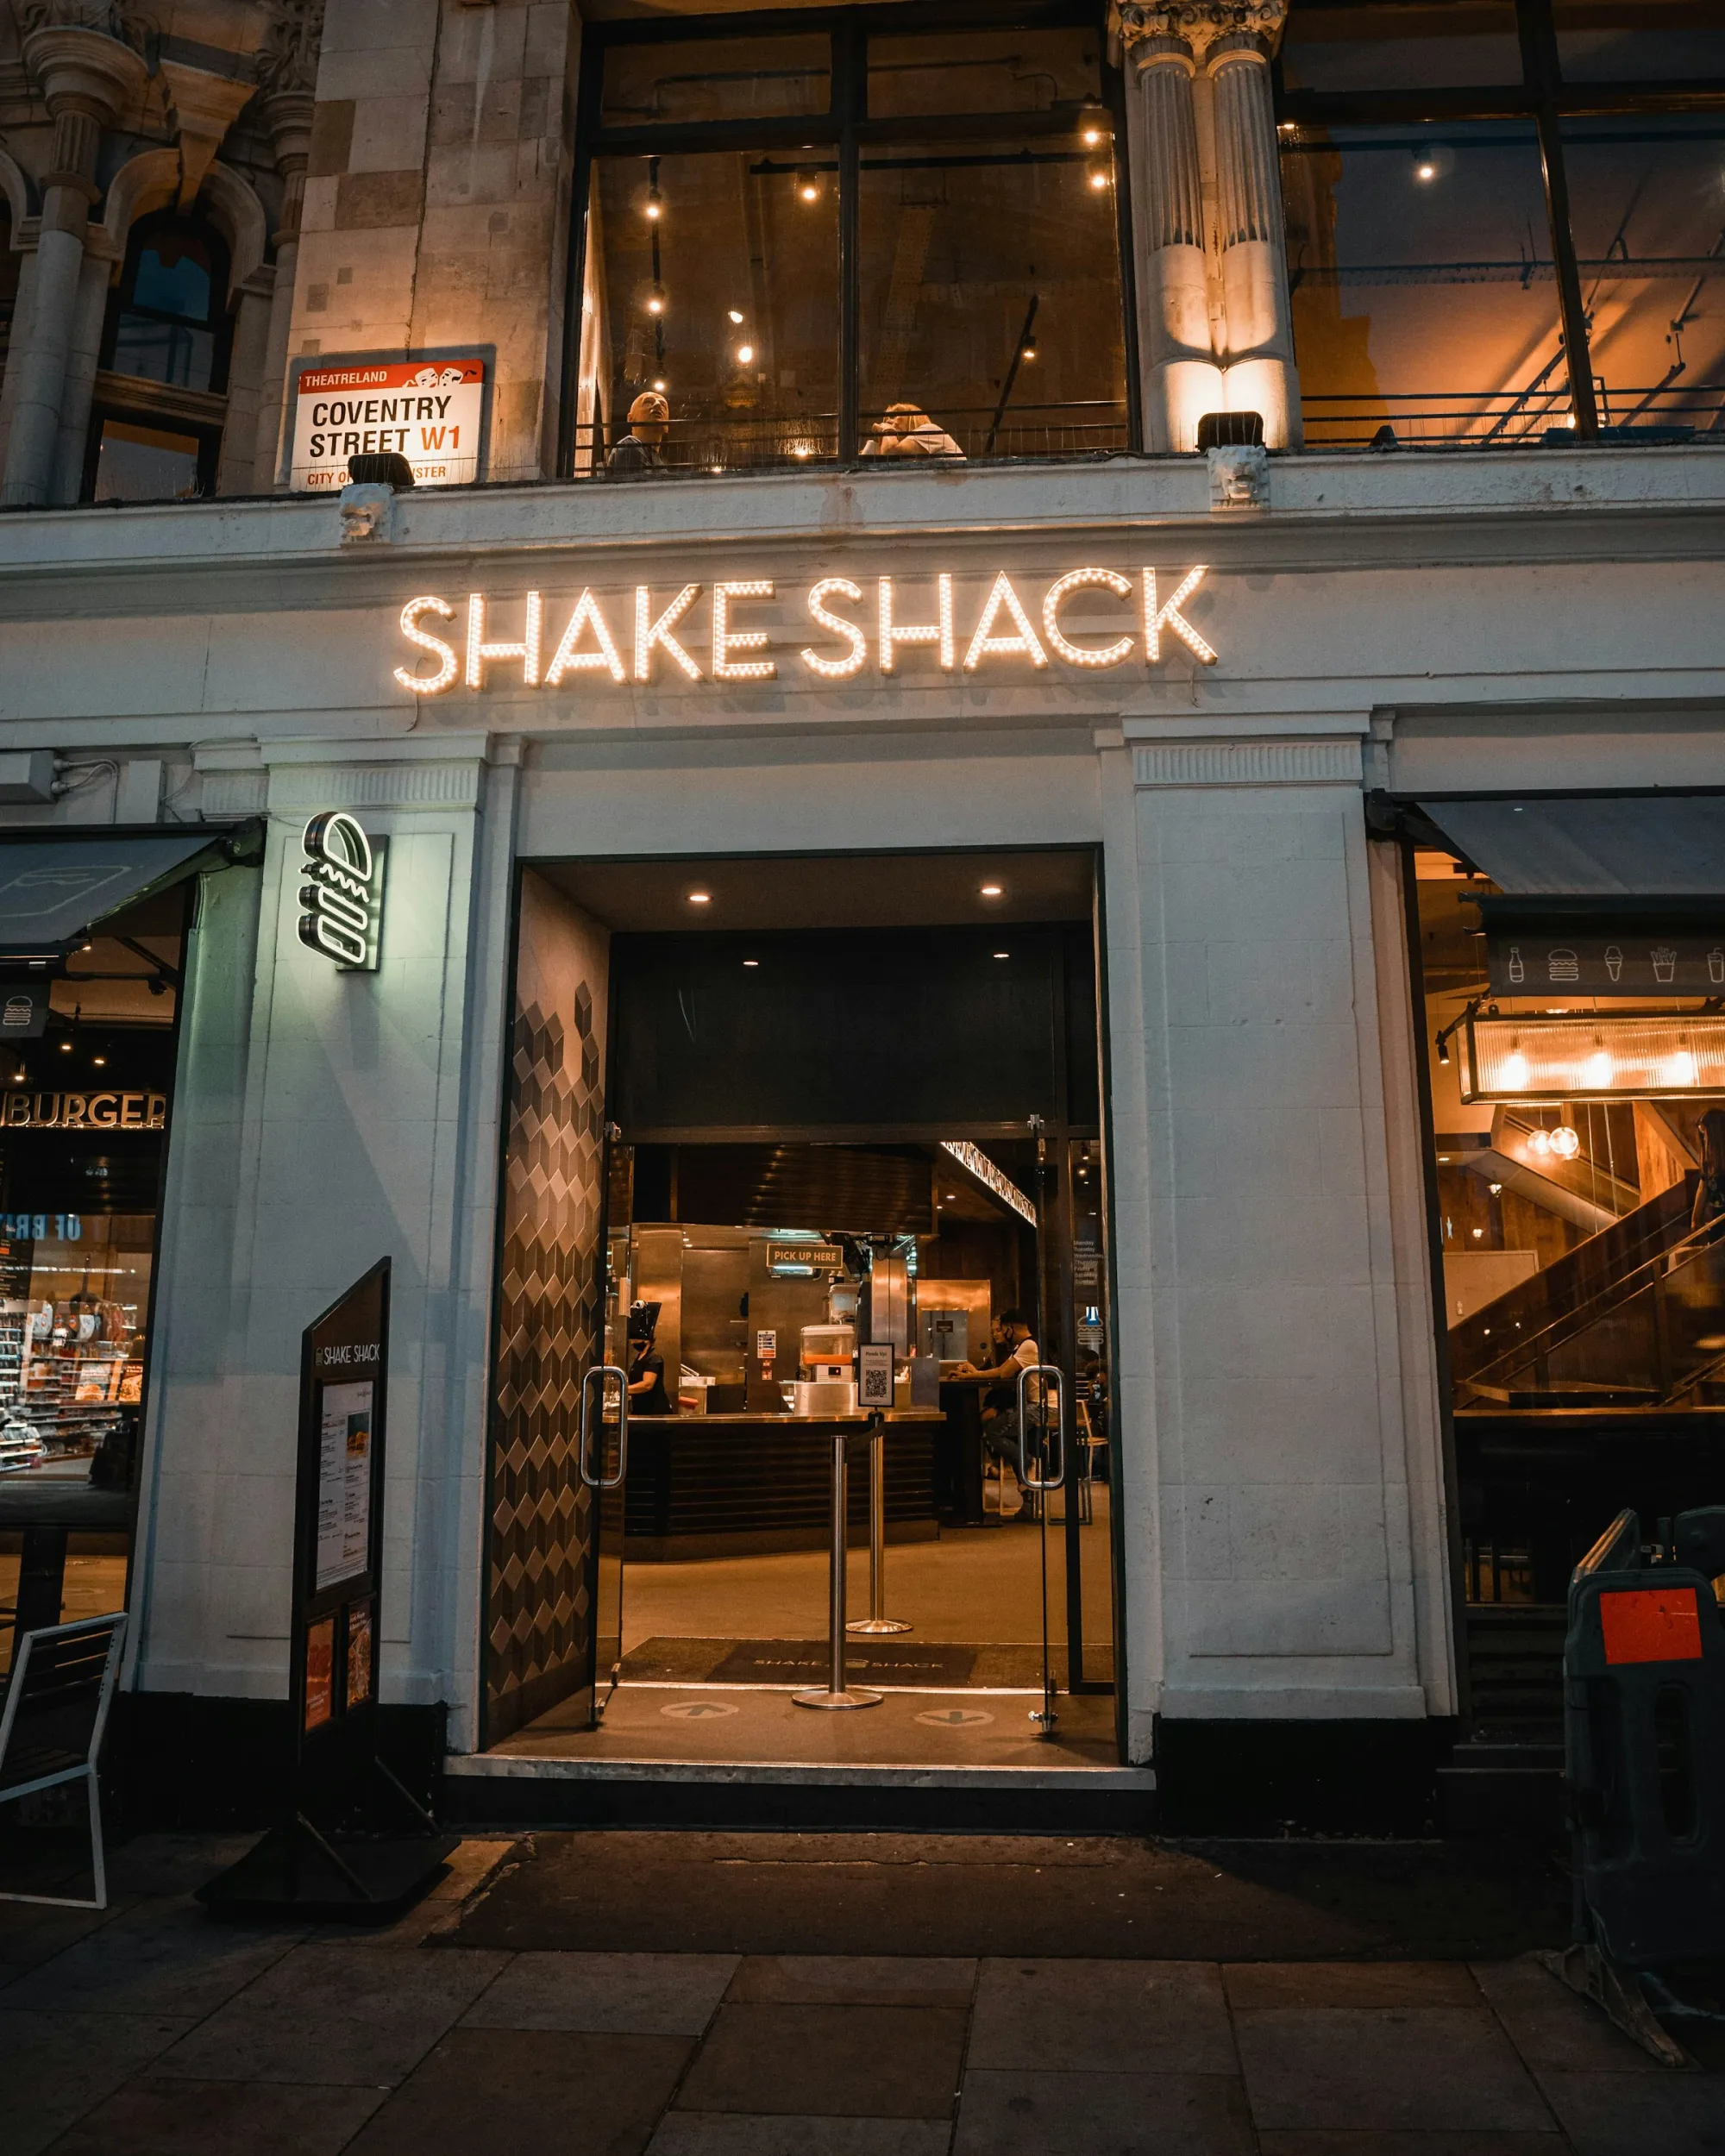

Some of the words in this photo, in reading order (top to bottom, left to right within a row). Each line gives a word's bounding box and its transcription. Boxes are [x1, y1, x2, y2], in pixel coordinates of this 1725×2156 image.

[305, 371, 387, 387] THEATRELAND
[312, 395, 452, 427] COVENTRY
[310, 429, 411, 458] STREET
[421, 425, 461, 451] W1
[308, 472, 335, 485] CITY
[393, 580, 778, 696] SHAKE
[800, 565, 1219, 680] SHACK
[0, 1091, 166, 1128] BURGER
[775, 1250, 796, 1261] PICK
[799, 1251, 812, 1261] UP
[813, 1251, 837, 1262] HERE
[323, 1345, 352, 1365] SHAKE
[354, 1343, 380, 1363] SHACK
